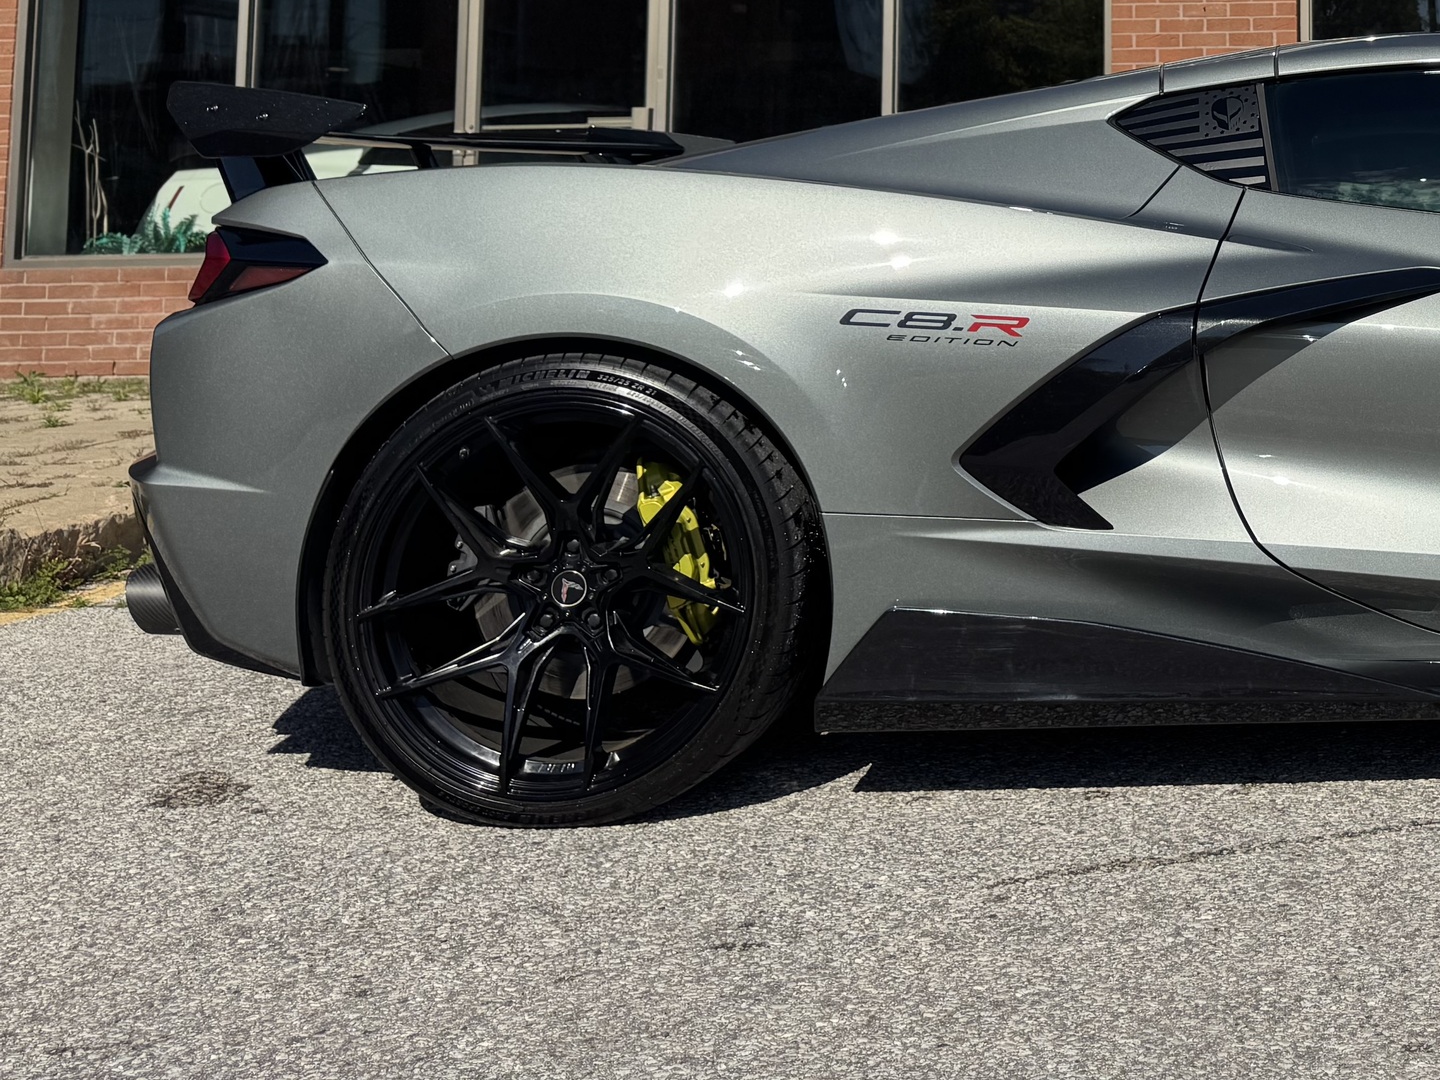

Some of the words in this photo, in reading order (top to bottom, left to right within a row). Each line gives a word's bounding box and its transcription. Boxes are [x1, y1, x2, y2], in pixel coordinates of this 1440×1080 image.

[839, 308, 1030, 338] C8.R
[886, 334, 1019, 347] EDITION
[498, 370, 591, 390] MICHELIN
